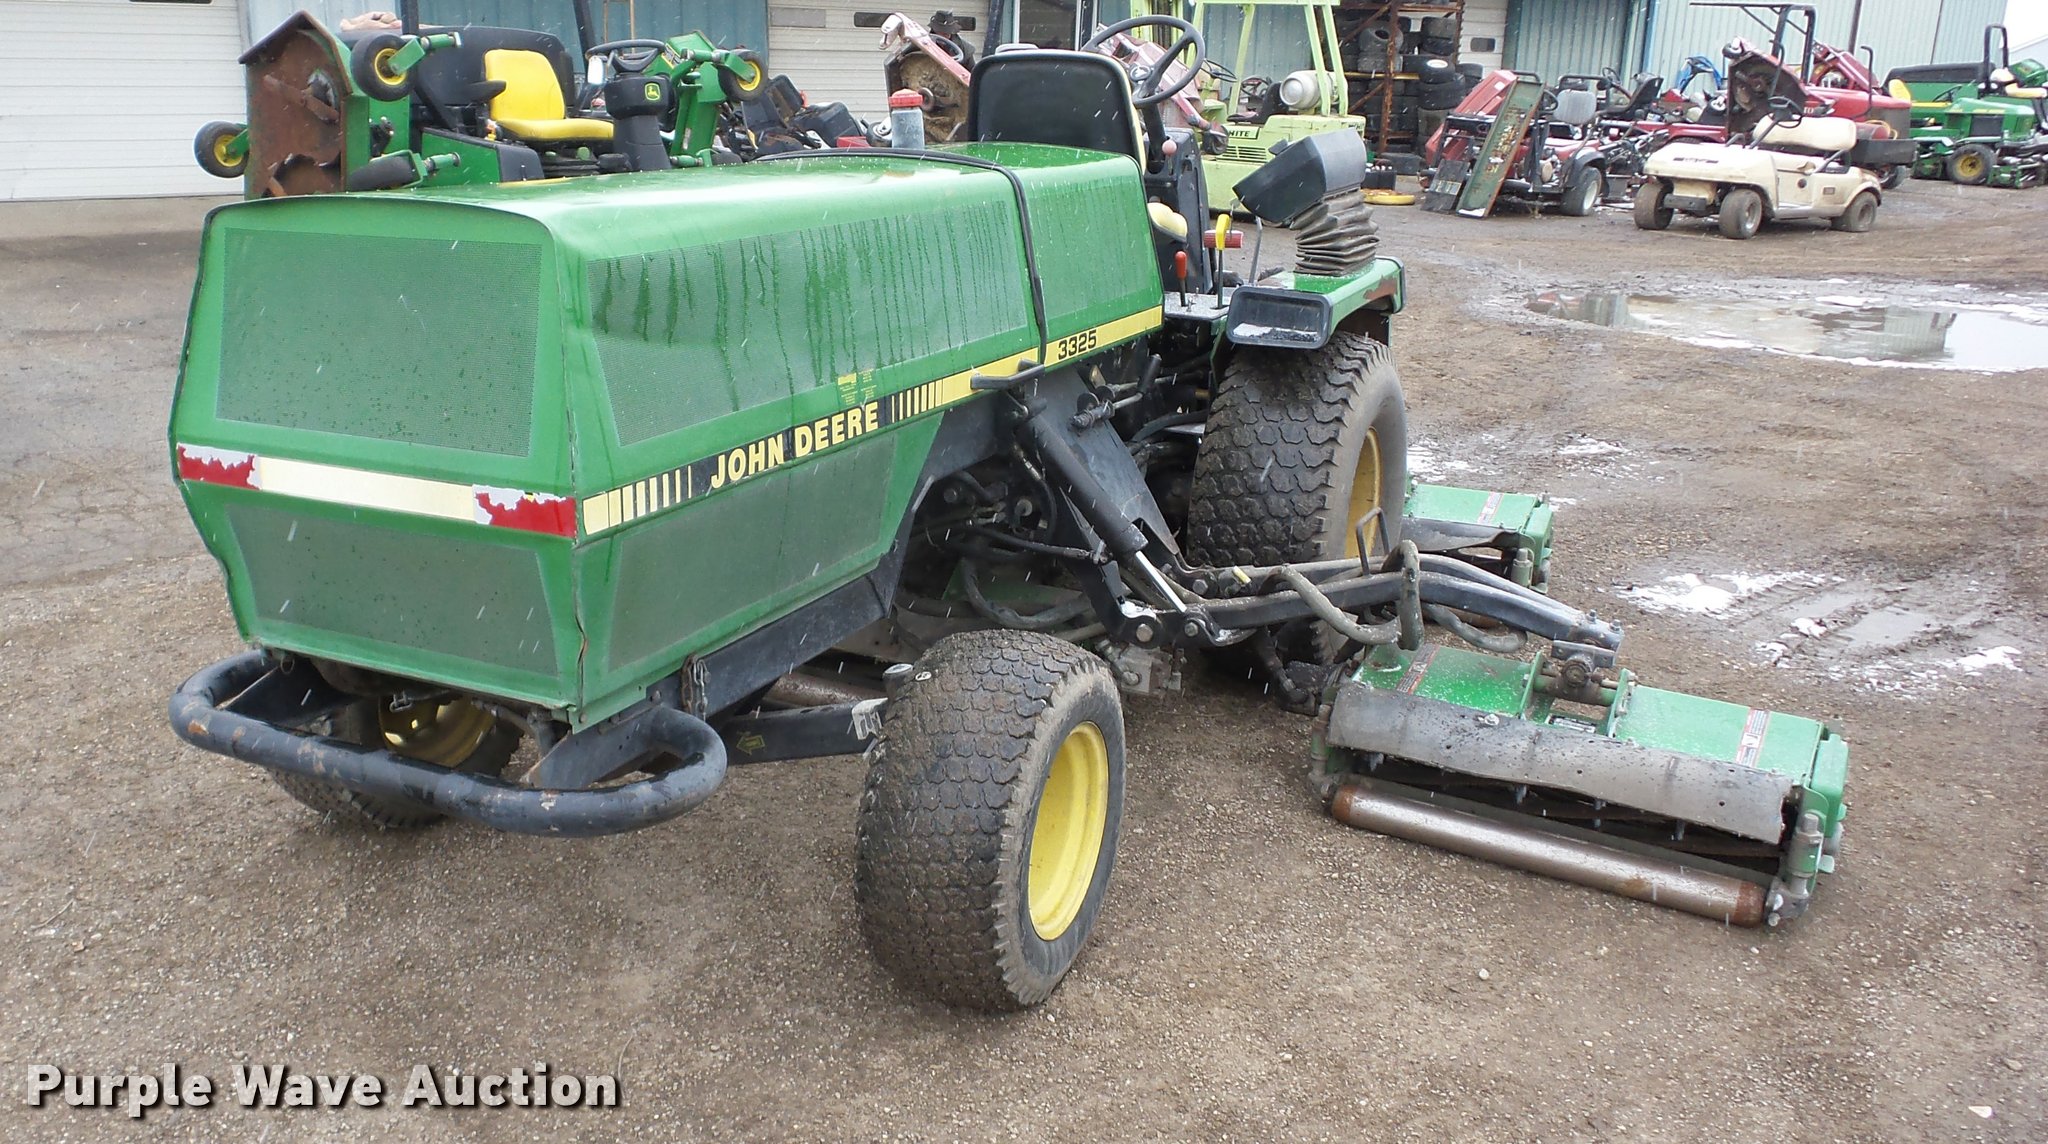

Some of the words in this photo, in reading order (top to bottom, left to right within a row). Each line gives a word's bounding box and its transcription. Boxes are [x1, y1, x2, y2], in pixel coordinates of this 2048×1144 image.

[1058, 329, 1097, 360] 3325
[710, 433, 785, 489] JOHN
[794, 403, 879, 458] DEERE
